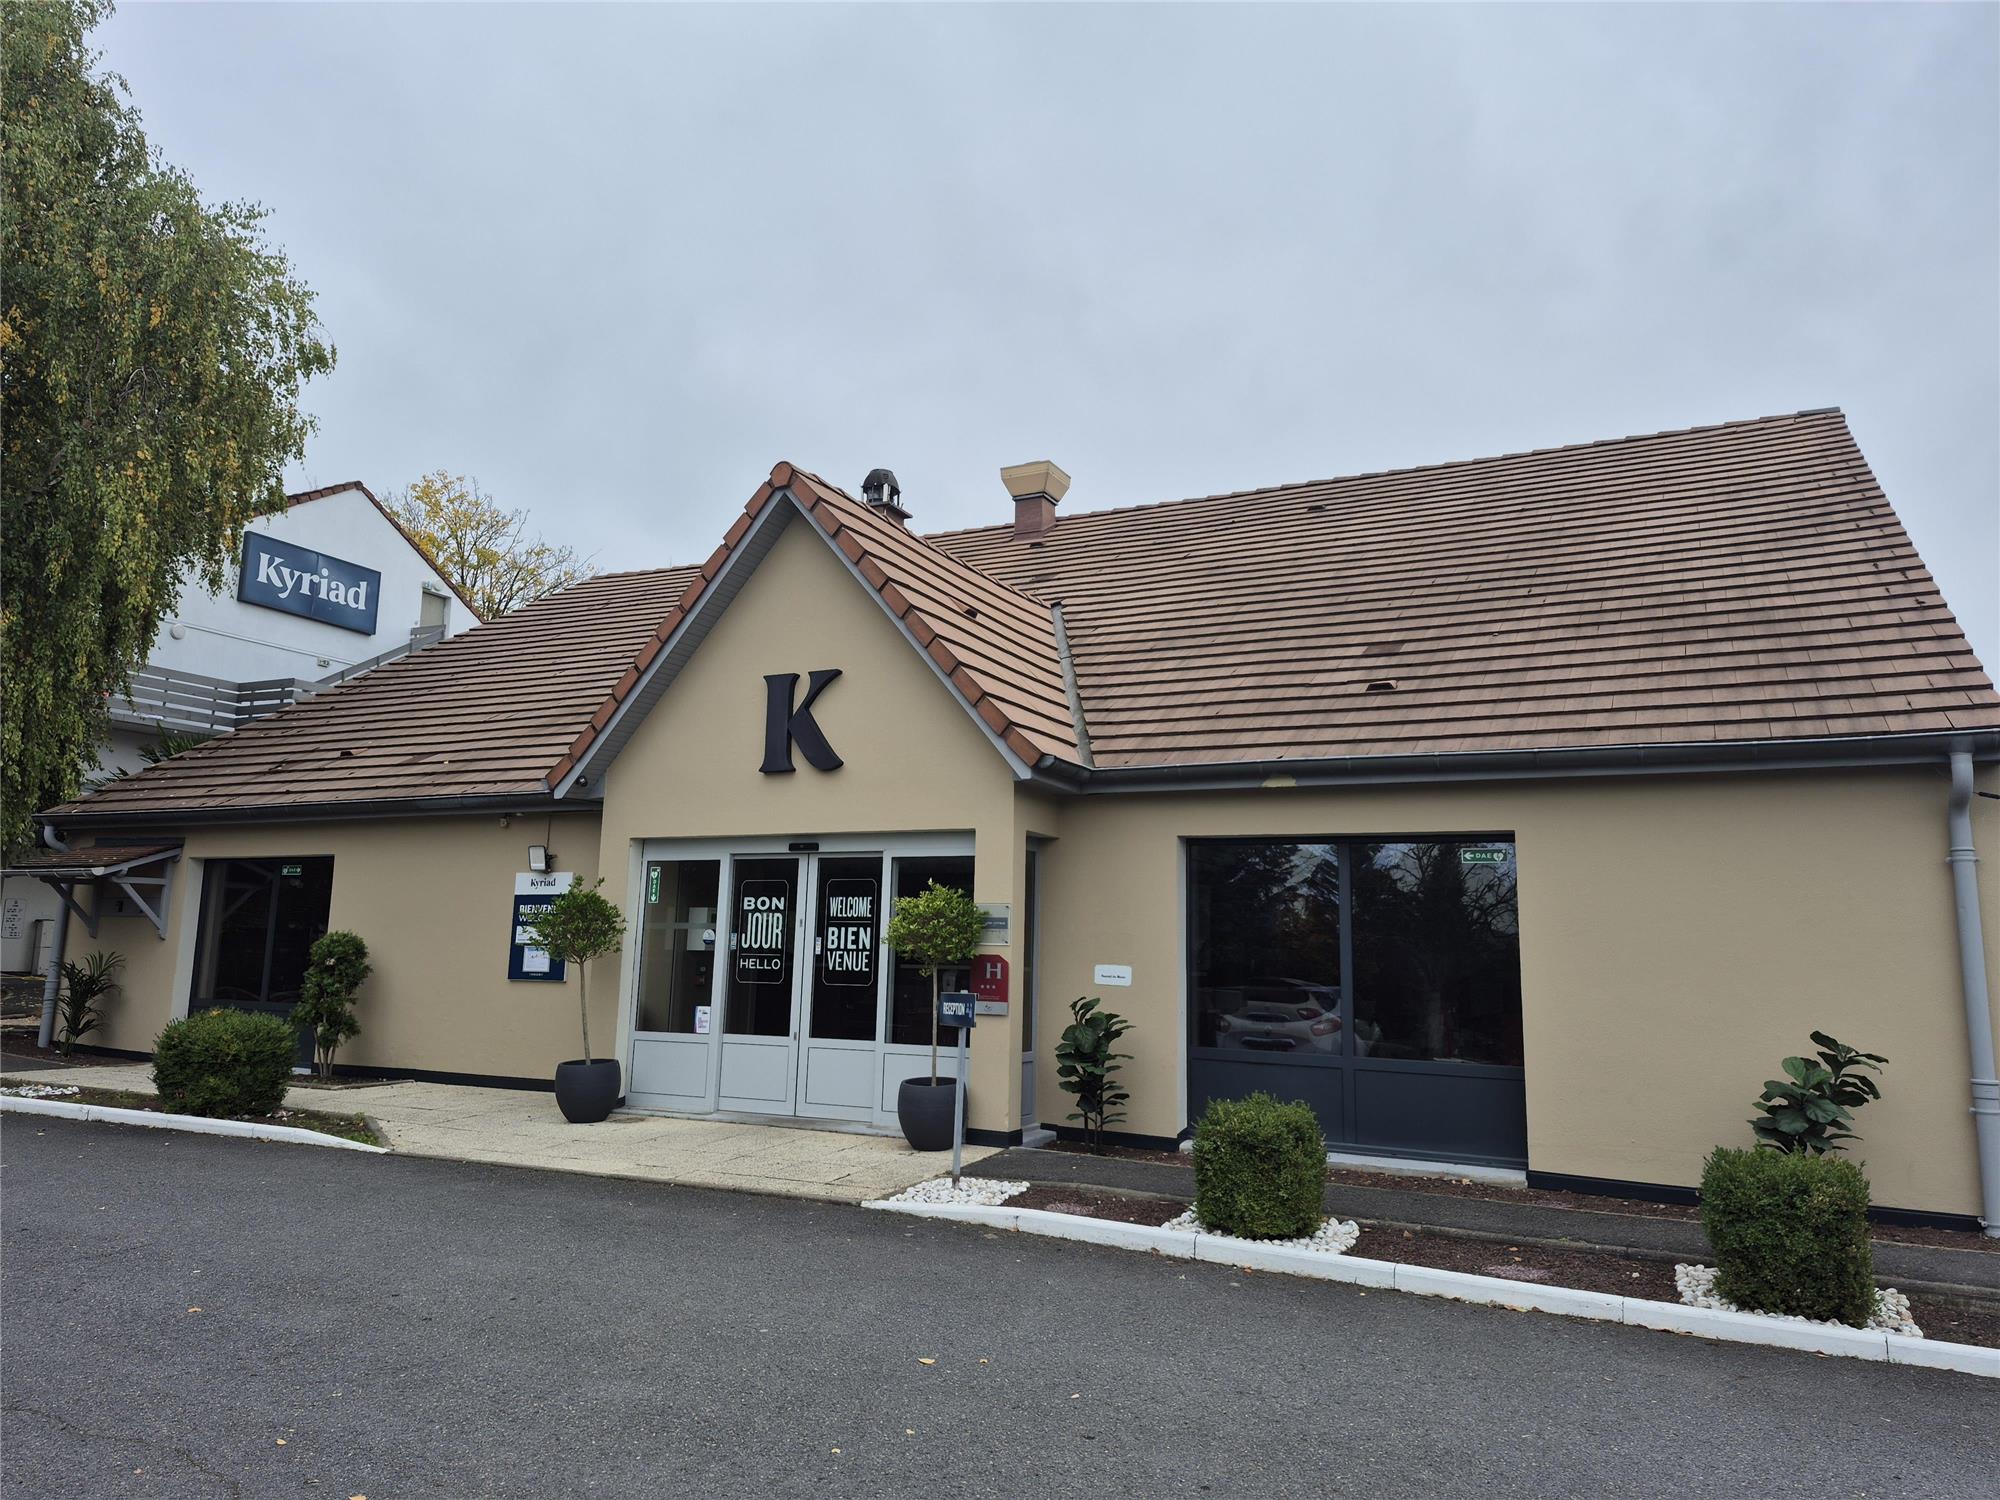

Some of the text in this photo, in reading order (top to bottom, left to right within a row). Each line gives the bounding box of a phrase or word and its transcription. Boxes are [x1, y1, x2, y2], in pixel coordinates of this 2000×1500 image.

[256, 552, 368, 611] Kyriad
[759, 669, 844, 773] K
[530, 878, 556, 889] Kyriad
[743, 896, 785, 911] BON
[829, 896, 872, 918] WELCOME
[741, 912, 783, 949] JOUR
[827, 926, 871, 950] BIEN
[739, 958, 781, 970] HELLO
[827, 951, 870, 971] VENUE
[985, 962, 1002, 979] H
[943, 1002, 966, 1016] RECEPTION
